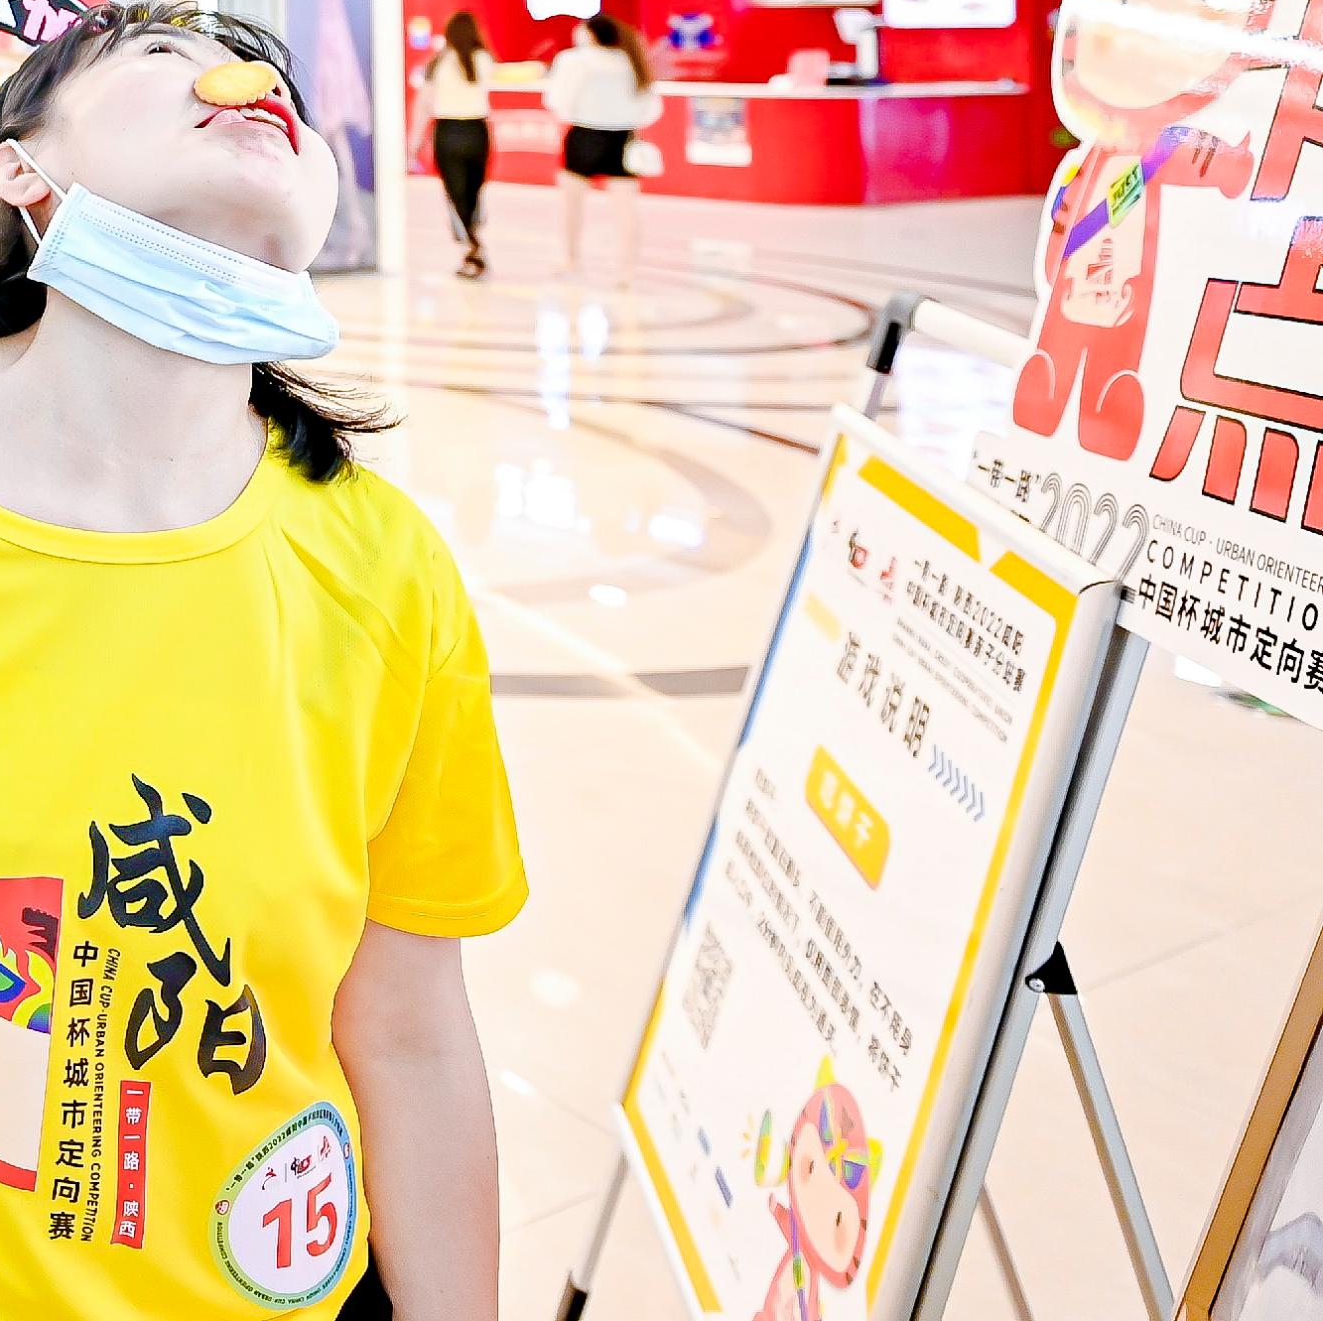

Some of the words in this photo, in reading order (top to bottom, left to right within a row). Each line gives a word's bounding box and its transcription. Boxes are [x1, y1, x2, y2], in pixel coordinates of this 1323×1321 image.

[1153, 514, 1182, 538] CHINA
[1216, 537, 1256, 567] URBAN
[77, 773, 266, 1095] 咸阳
[103, 948, 121, 981] CHINA
[48, 941, 99, 1240] 中国杯城市定向赛
[90, 1062, 105, 1157] ORIENTEERING
[81, 1163, 101, 1242] COMPETITION
[262, 1172, 338, 1269] 15
